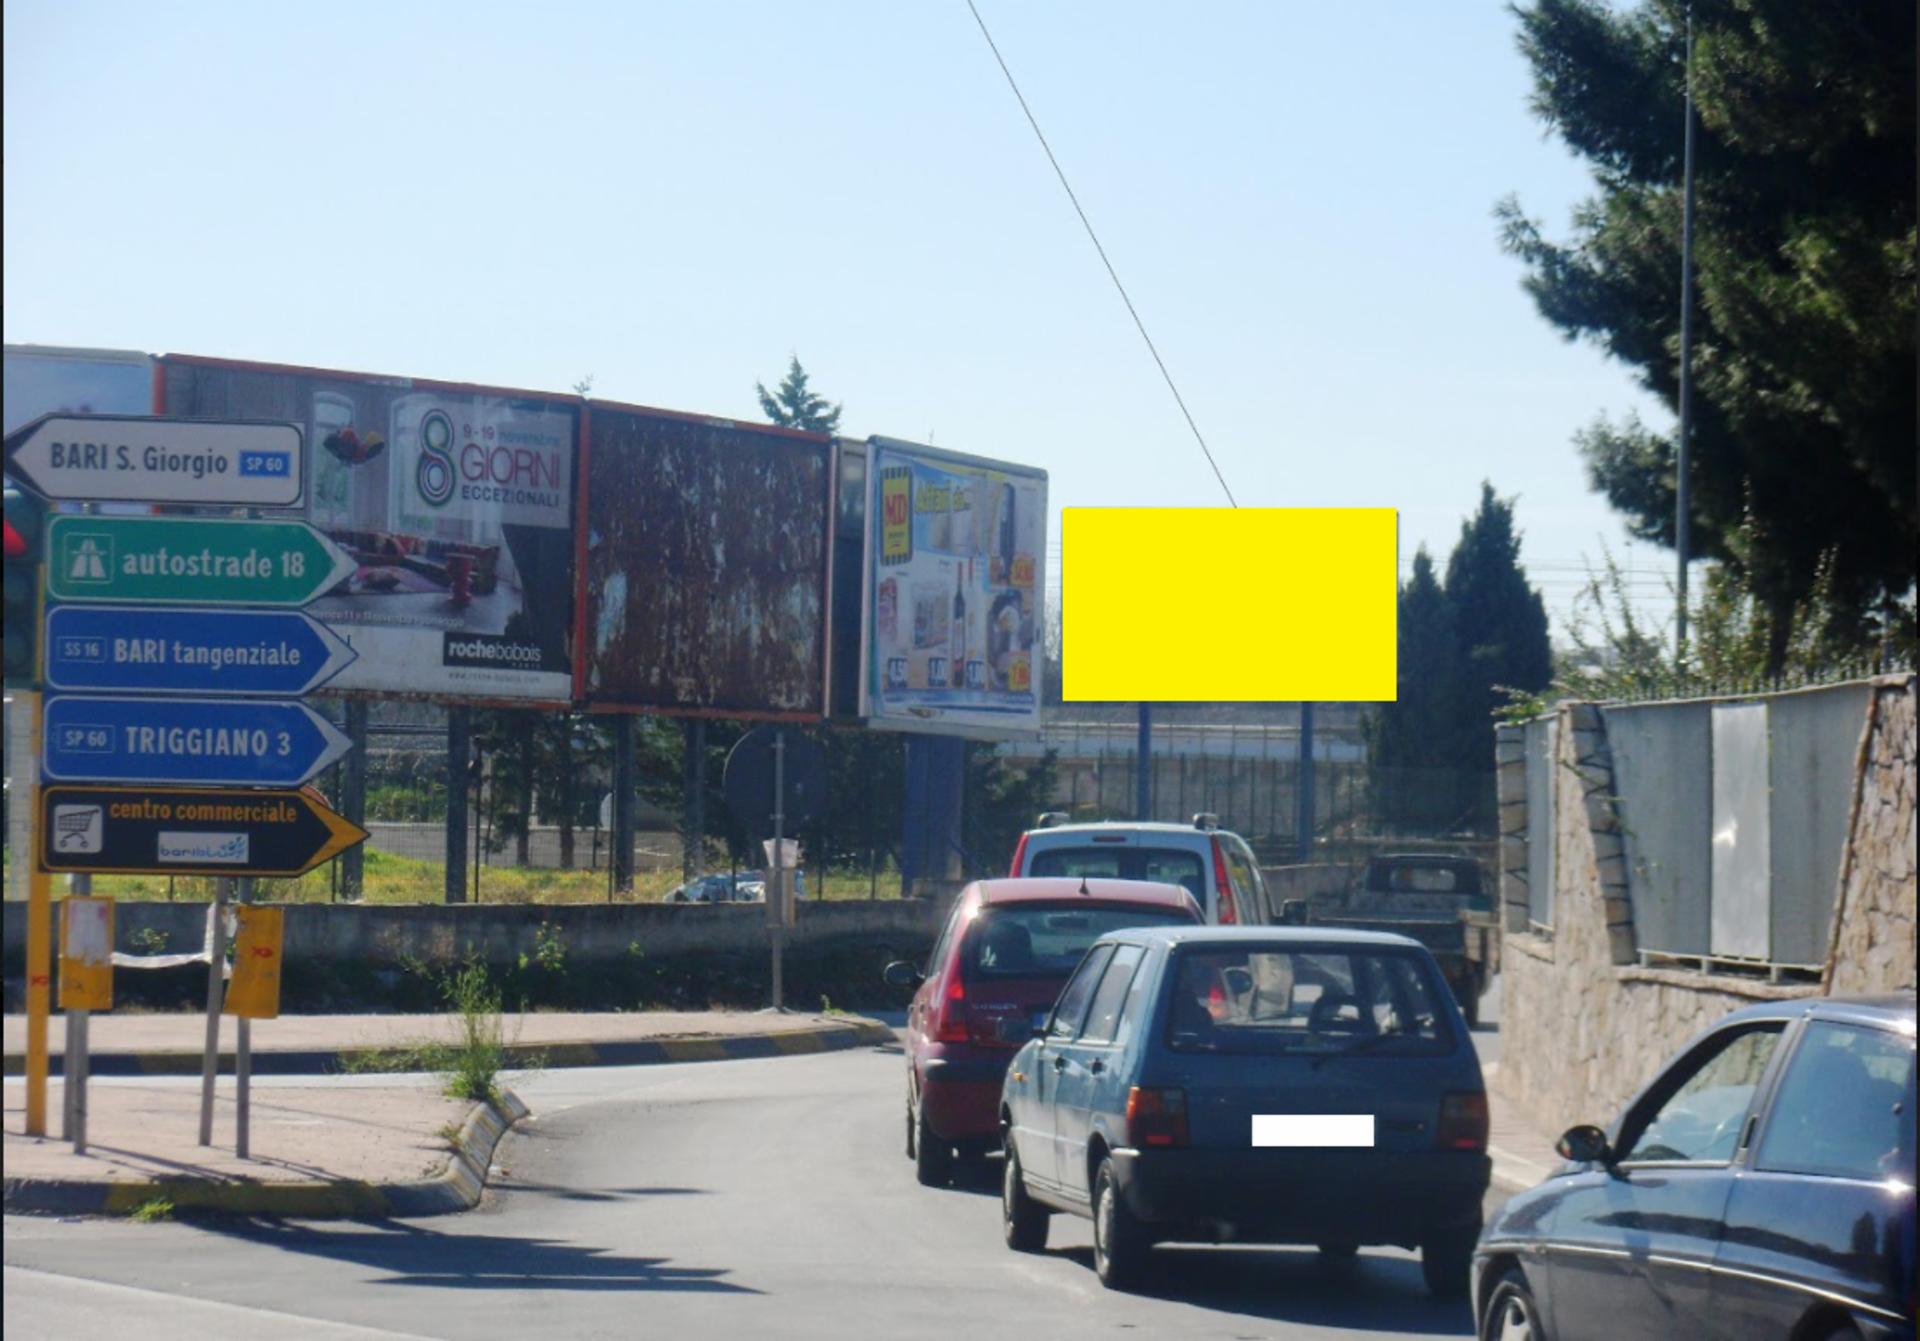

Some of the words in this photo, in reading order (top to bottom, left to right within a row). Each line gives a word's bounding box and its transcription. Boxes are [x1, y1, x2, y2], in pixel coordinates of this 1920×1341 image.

[50, 442, 108, 470] BARI
[115, 445, 136, 471] S.
[143, 446, 228, 480] Giorgio
[246, 457, 264, 471] SP
[265, 457, 283, 472] 60
[417, 408, 457, 507] 8
[460, 442, 560, 491] GIORNI
[461, 484, 560, 507] ECCEZIONALI
[123, 547, 273, 578] autostrade
[281, 551, 305, 578] 18
[65, 642, 81, 657] SS
[84, 642, 100, 657] 16
[114, 638, 167, 664] BARI
[173, 641, 301, 670] tangenziale
[448, 640, 542, 662] rochebobois
[65, 730, 84, 747] SP
[87, 731, 107, 748] 60
[125, 726, 269, 757] TRIGGIANO
[276, 732, 292, 757] 3
[110, 799, 172, 820] centro
[175, 801, 298, 823] commerciale
